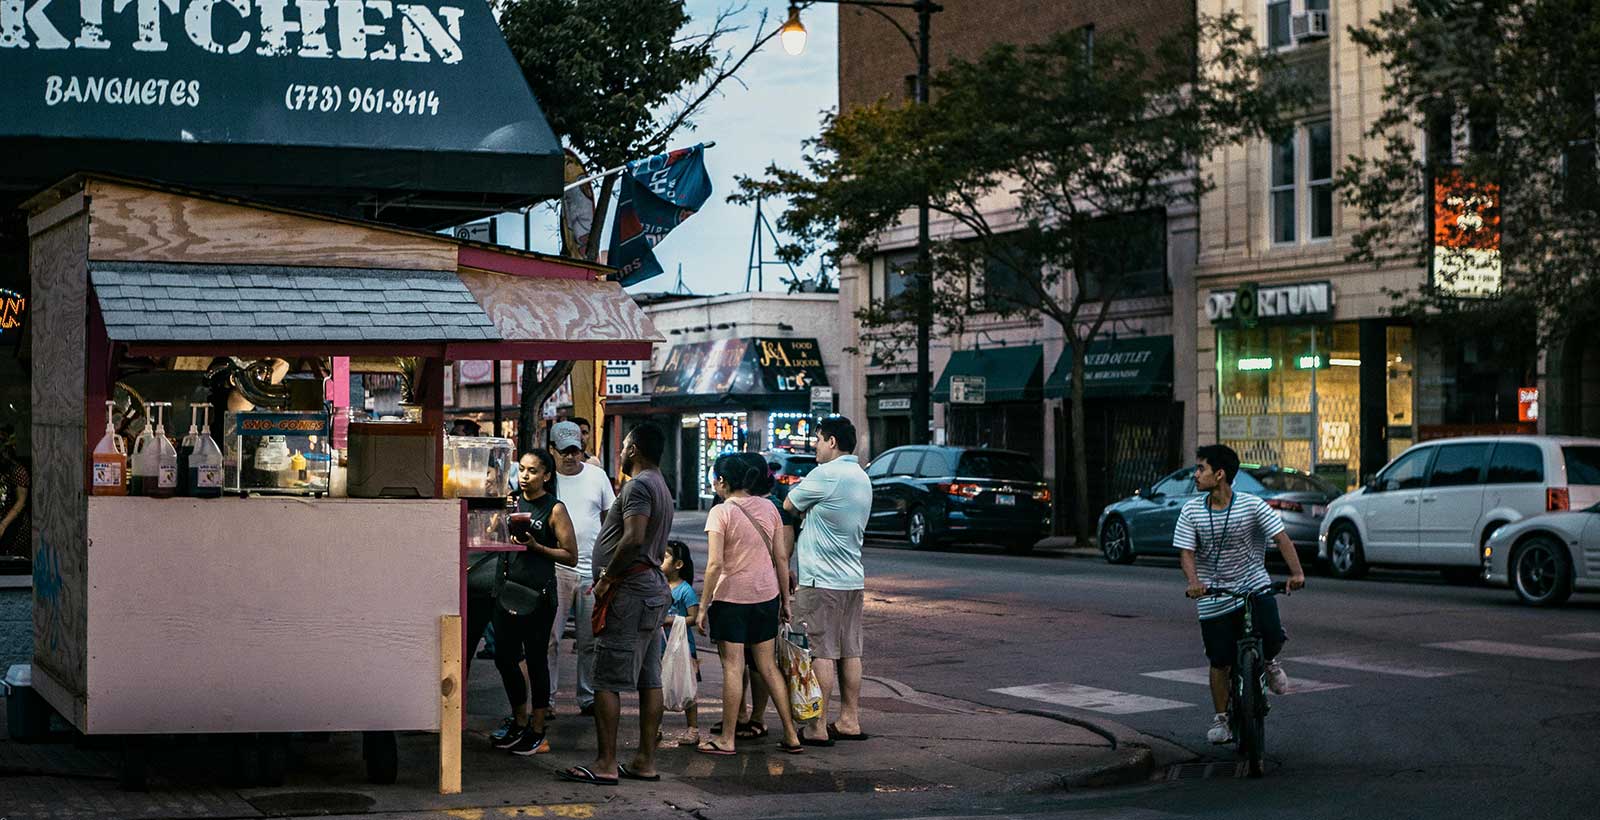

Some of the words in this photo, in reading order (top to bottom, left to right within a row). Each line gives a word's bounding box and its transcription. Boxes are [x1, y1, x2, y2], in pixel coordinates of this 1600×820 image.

[0, 0, 465, 64] KITCHEN
[44, 75, 200, 107] BANQUETES
[285, 83, 342, 112] (773)
[760, 341, 792, 367] J&A
[791, 342, 813, 350] FOOD
[792, 360, 821, 368] LIQUOR
[608, 384, 640, 394] 1904
